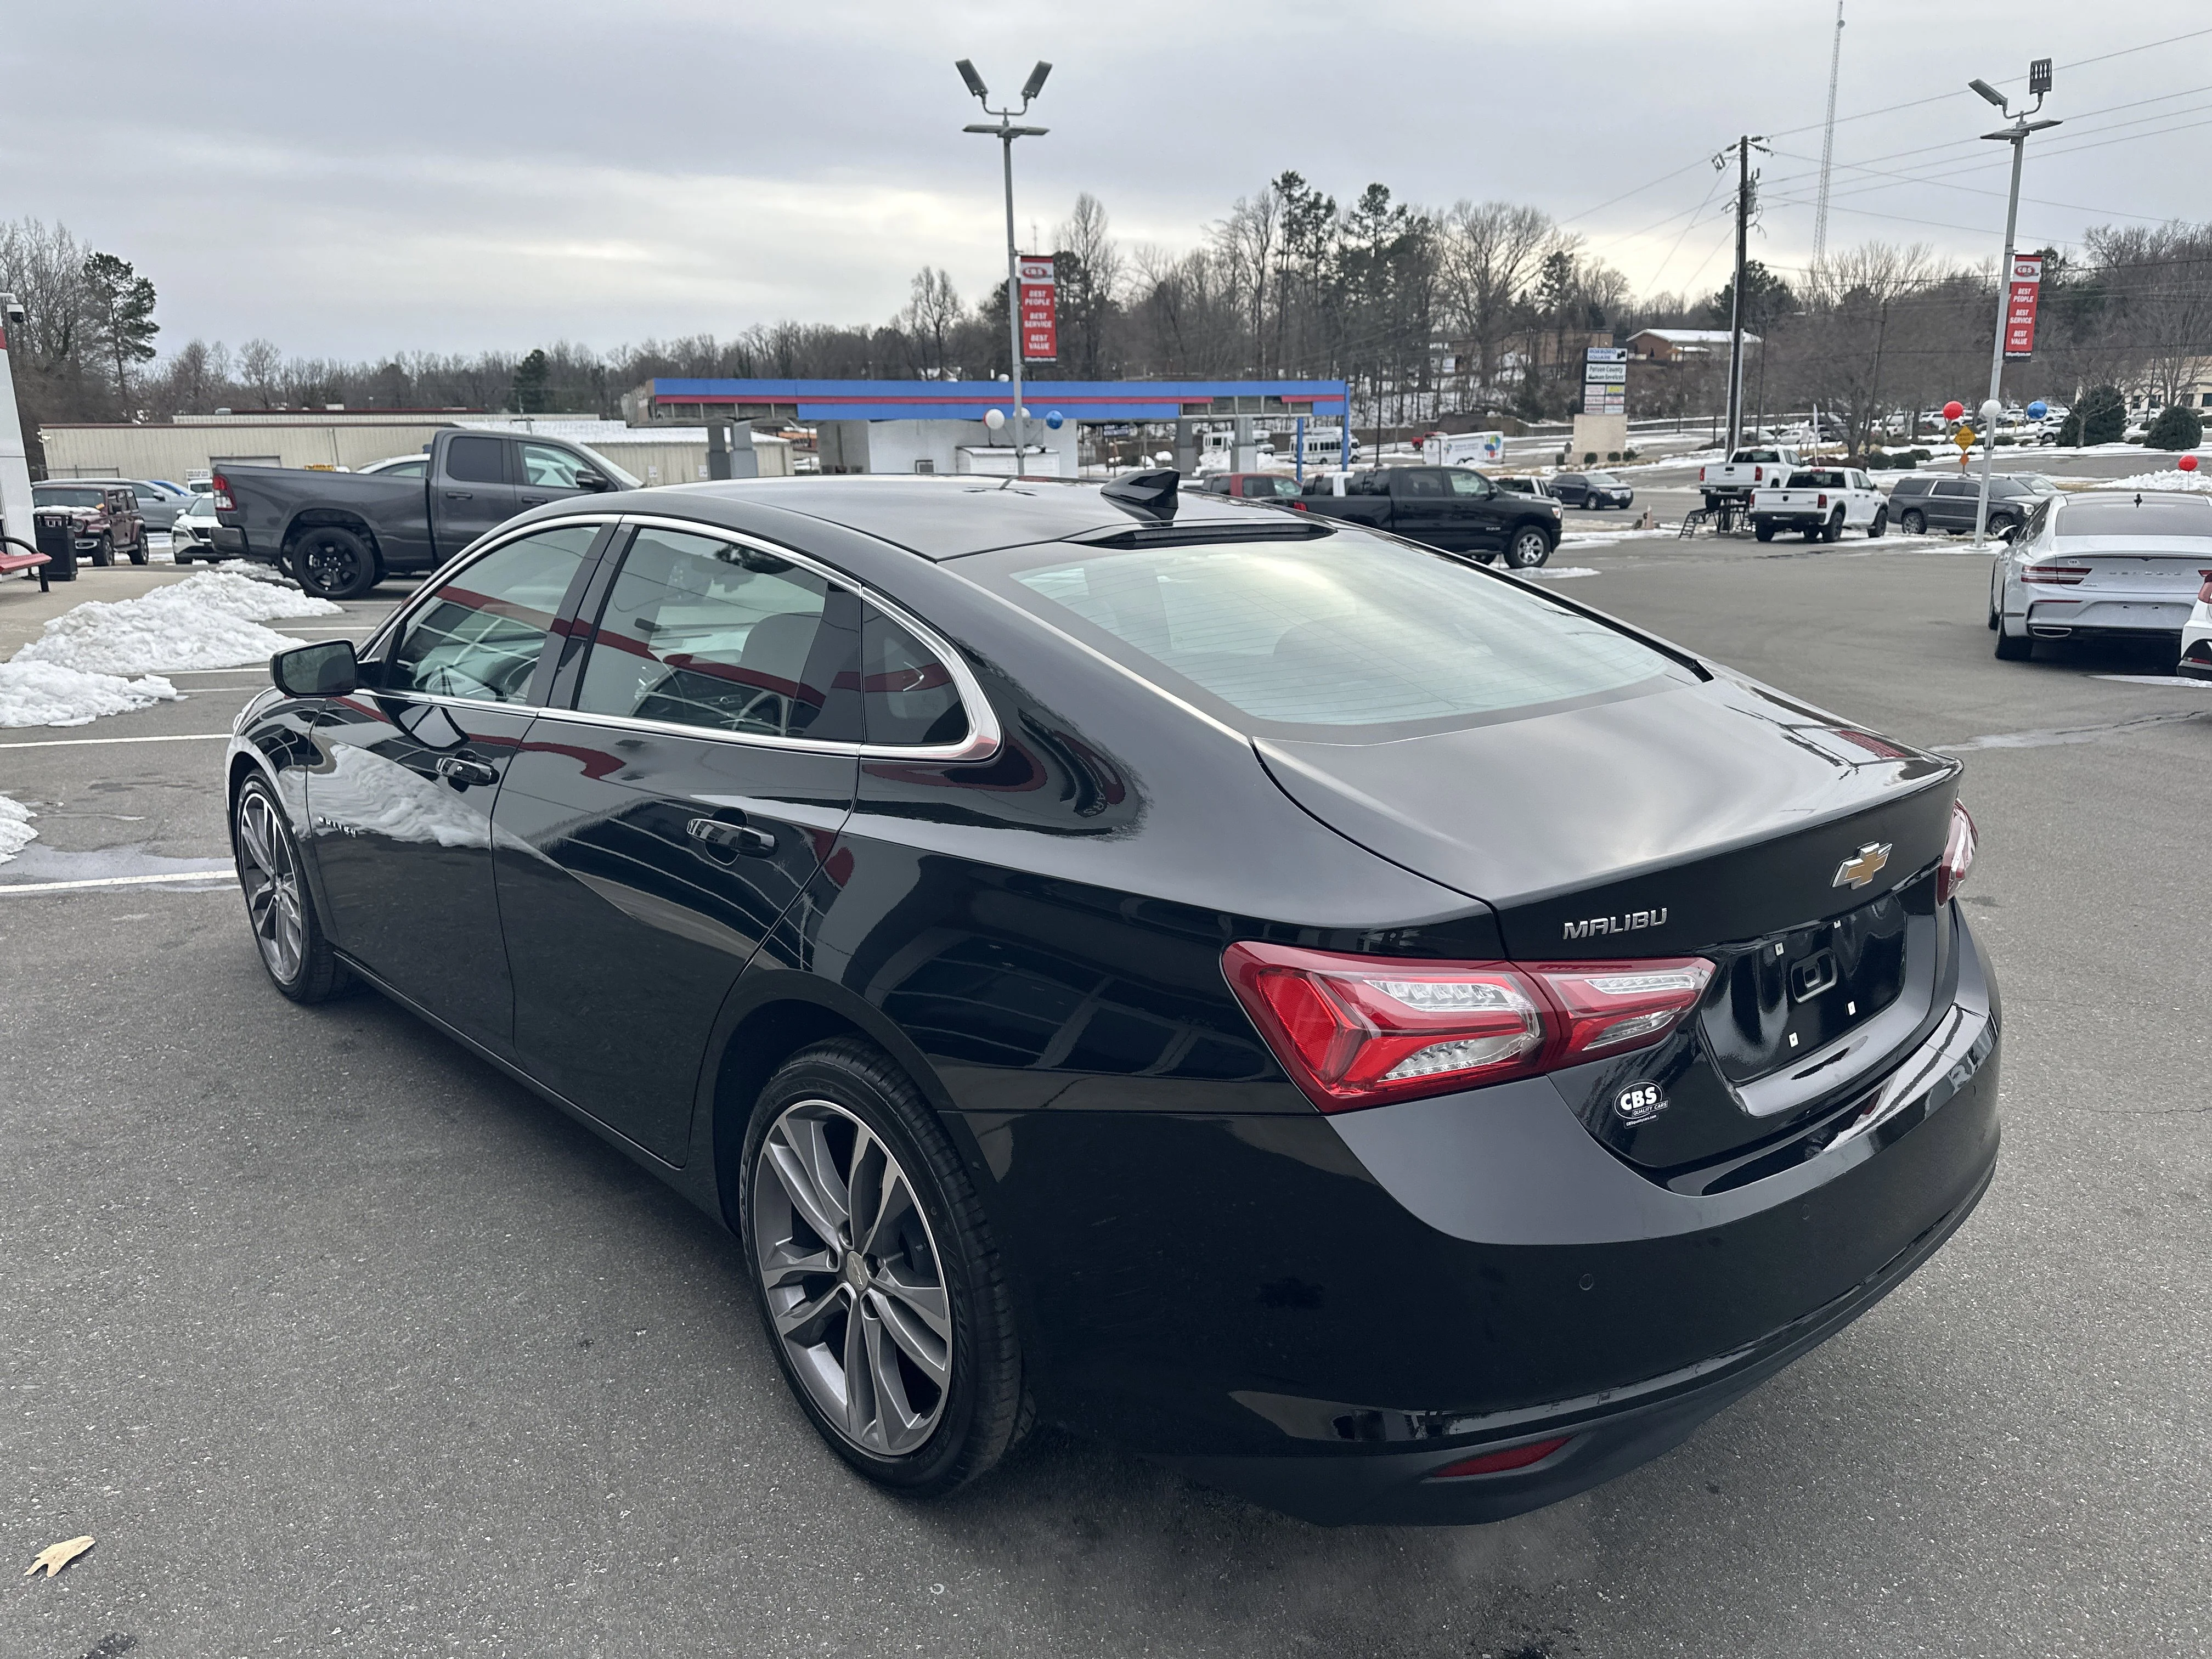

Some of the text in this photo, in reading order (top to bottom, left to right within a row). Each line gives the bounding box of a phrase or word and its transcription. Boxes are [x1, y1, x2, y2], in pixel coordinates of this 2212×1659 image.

[1024, 298, 1051, 306] PEOPLE
[1024, 320, 1053, 329] SERVICE
[1028, 342, 1051, 351] VALUE
[1562, 907, 1668, 940] MALIBU
[1620, 1086, 1657, 1111] CBS
[1633, 1106, 1653, 1115] QUALITY
